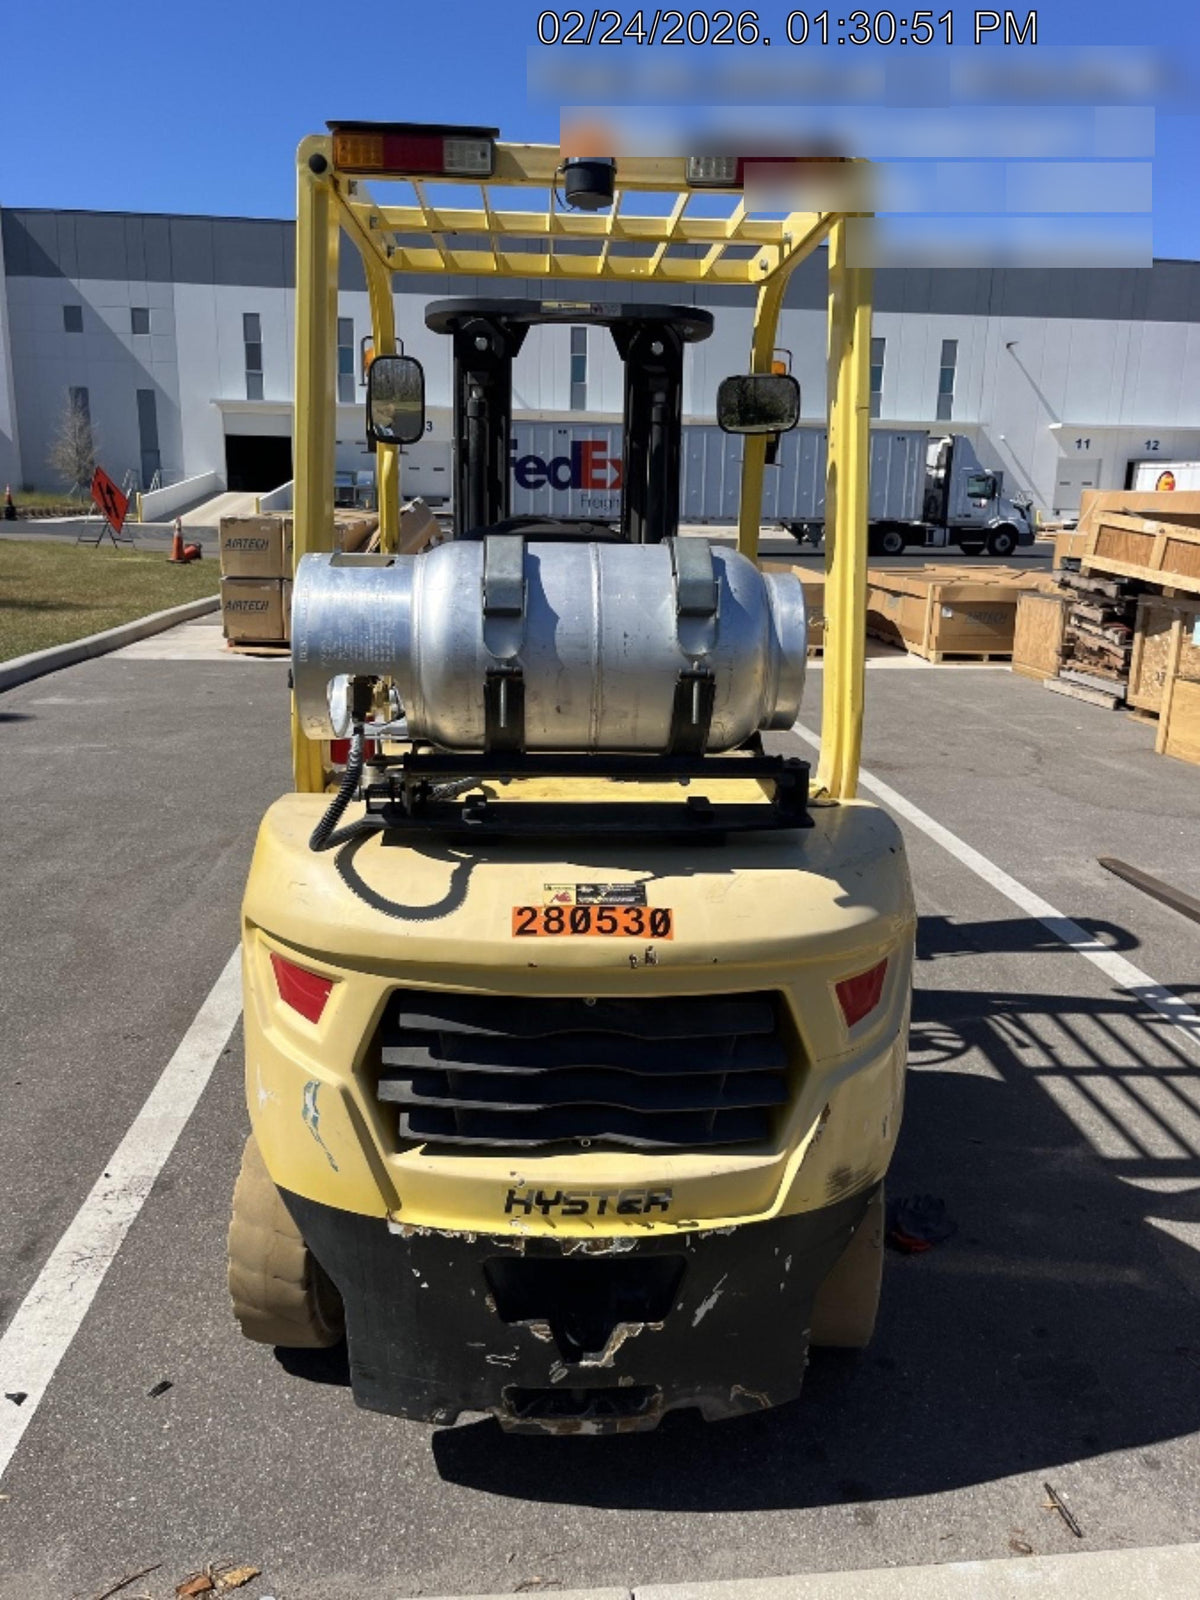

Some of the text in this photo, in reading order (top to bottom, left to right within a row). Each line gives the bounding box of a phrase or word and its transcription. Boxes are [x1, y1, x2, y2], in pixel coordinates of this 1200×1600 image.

[1075, 438, 1091, 449] 11
[1144, 440, 1160, 451] 12
[581, 494, 620, 511] Freigh
[224, 538, 269, 550] AIRTECH
[224, 600, 269, 611] AIRTECH
[515, 906, 671, 938] 280530
[504, 1189, 673, 1216] HYSTER
